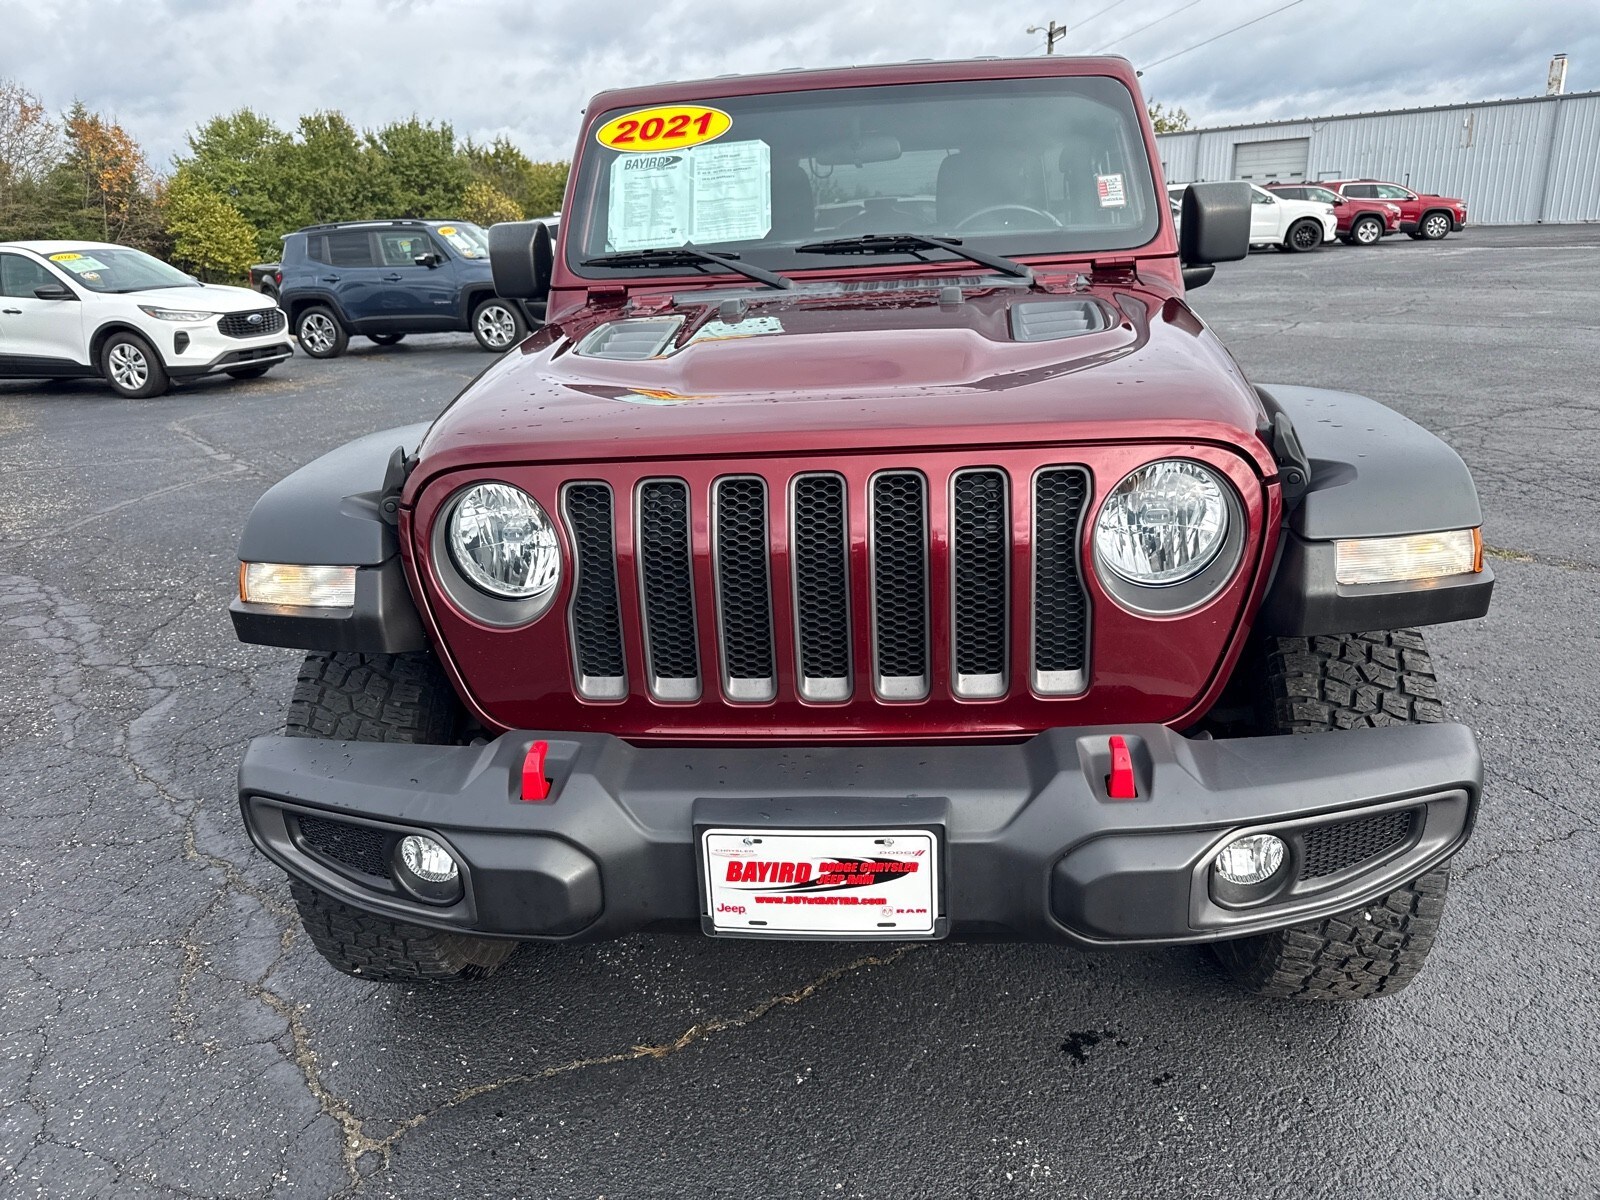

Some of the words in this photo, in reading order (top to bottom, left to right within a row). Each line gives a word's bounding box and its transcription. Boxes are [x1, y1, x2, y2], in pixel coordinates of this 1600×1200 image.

[611, 112, 713, 144] 2021
[624, 156, 666, 170] BAYIRD
[726, 861, 812, 883] BAYIRD
[819, 862, 858, 873] DODGE
[860, 862, 919, 873] CHRYSLER
[816, 874, 845, 884] JEEP
[847, 874, 875, 884] RAM
[717, 903, 746, 914] Jeep
